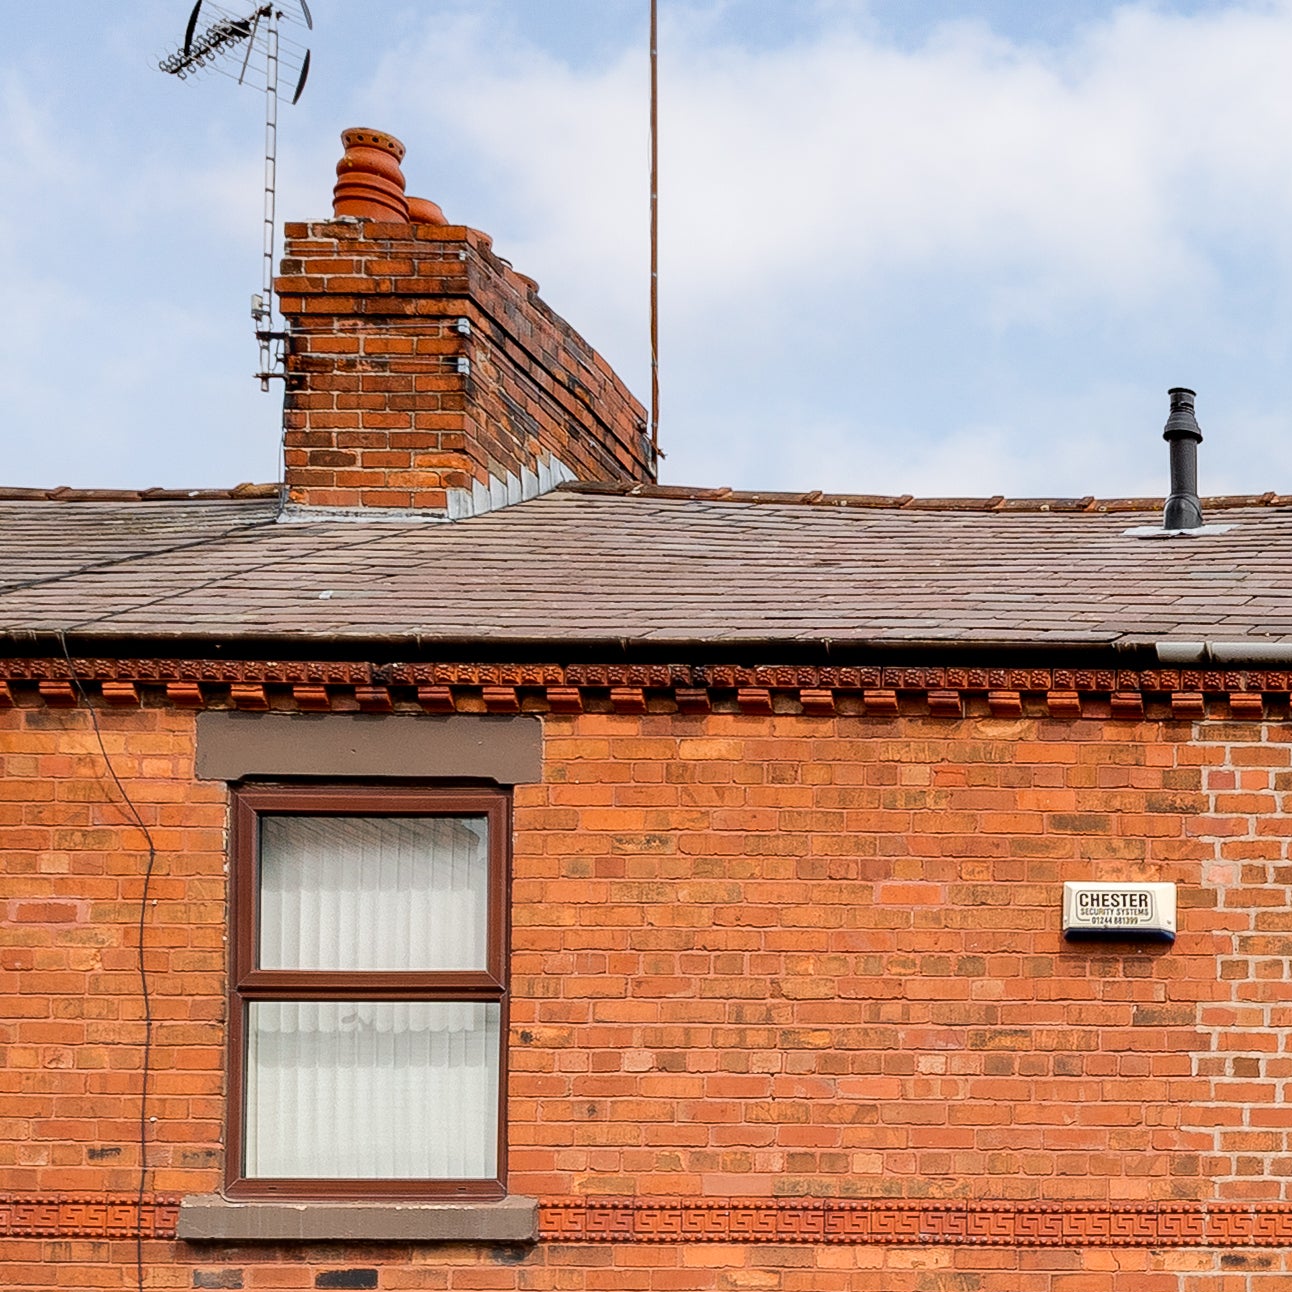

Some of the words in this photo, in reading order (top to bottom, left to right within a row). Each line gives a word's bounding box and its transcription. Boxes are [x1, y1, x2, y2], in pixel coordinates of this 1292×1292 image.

[1079, 893, 1149, 908] CHESTER
[1080, 908, 1114, 916] SECURITY
[1116, 908, 1149, 916] SYSTEMS
[1091, 916, 1113, 925] 01244
